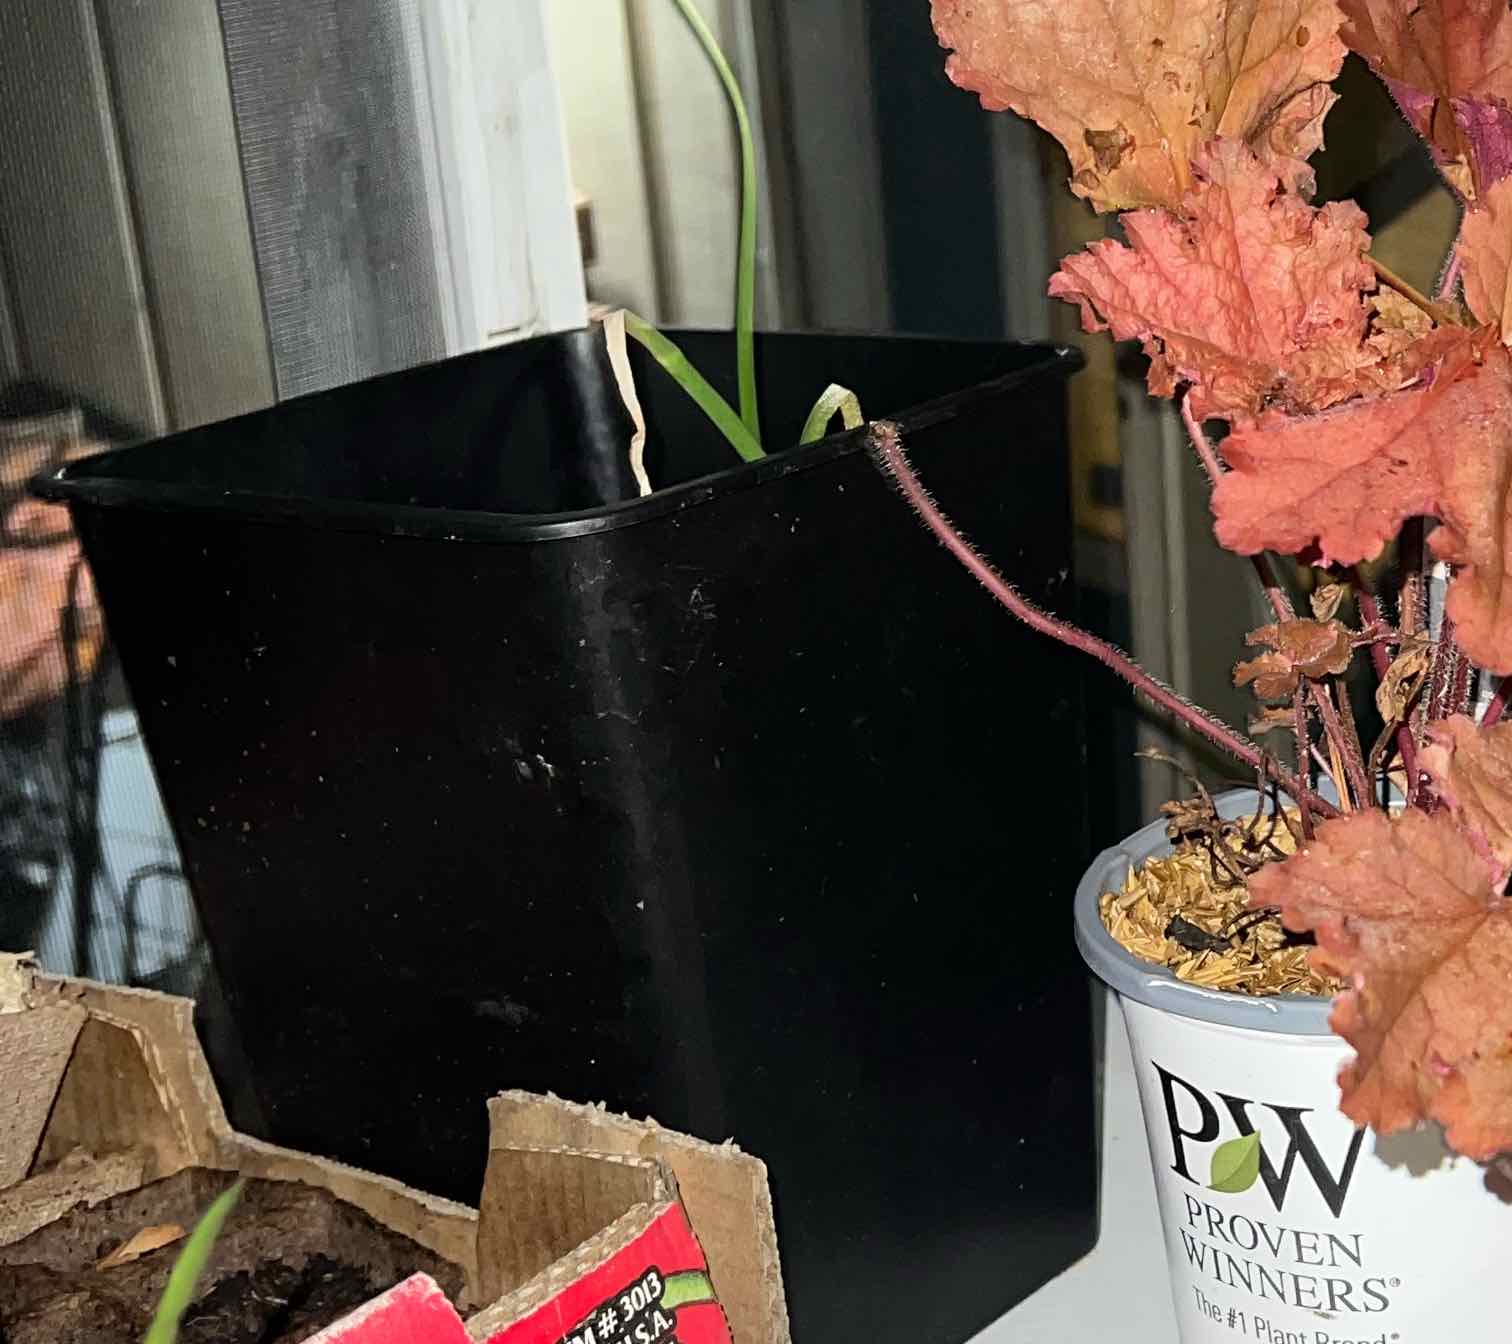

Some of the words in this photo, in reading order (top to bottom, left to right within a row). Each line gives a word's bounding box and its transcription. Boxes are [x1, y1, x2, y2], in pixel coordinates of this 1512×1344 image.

[1184, 1192, 1364, 1268] PROVEN
[598, 1309, 619, 1340] #
[619, 1272, 662, 1322] 3013
[1193, 1284, 1222, 1323] The
[1227, 1308, 1247, 1335] #1
